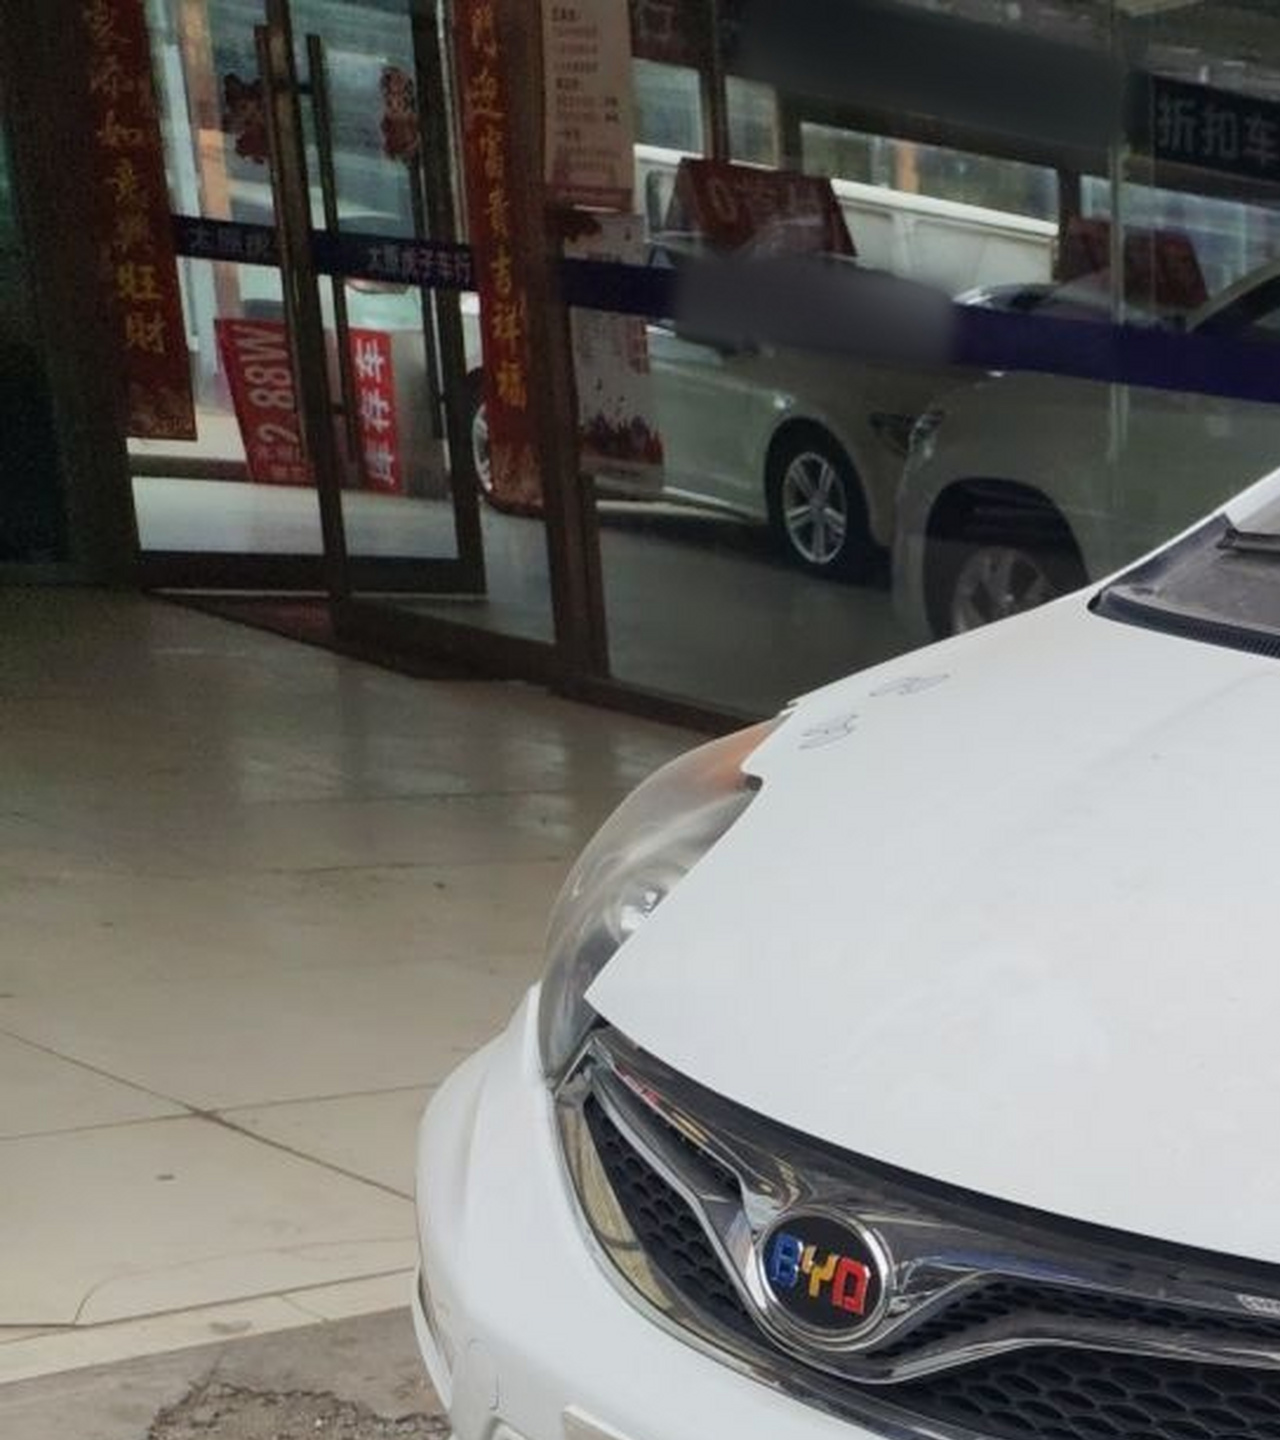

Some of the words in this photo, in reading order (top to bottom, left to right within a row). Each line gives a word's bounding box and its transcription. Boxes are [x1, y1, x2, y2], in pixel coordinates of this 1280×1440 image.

[1157, 97, 1280, 167] 折扣车
[770, 1233, 870, 1315] BYD
